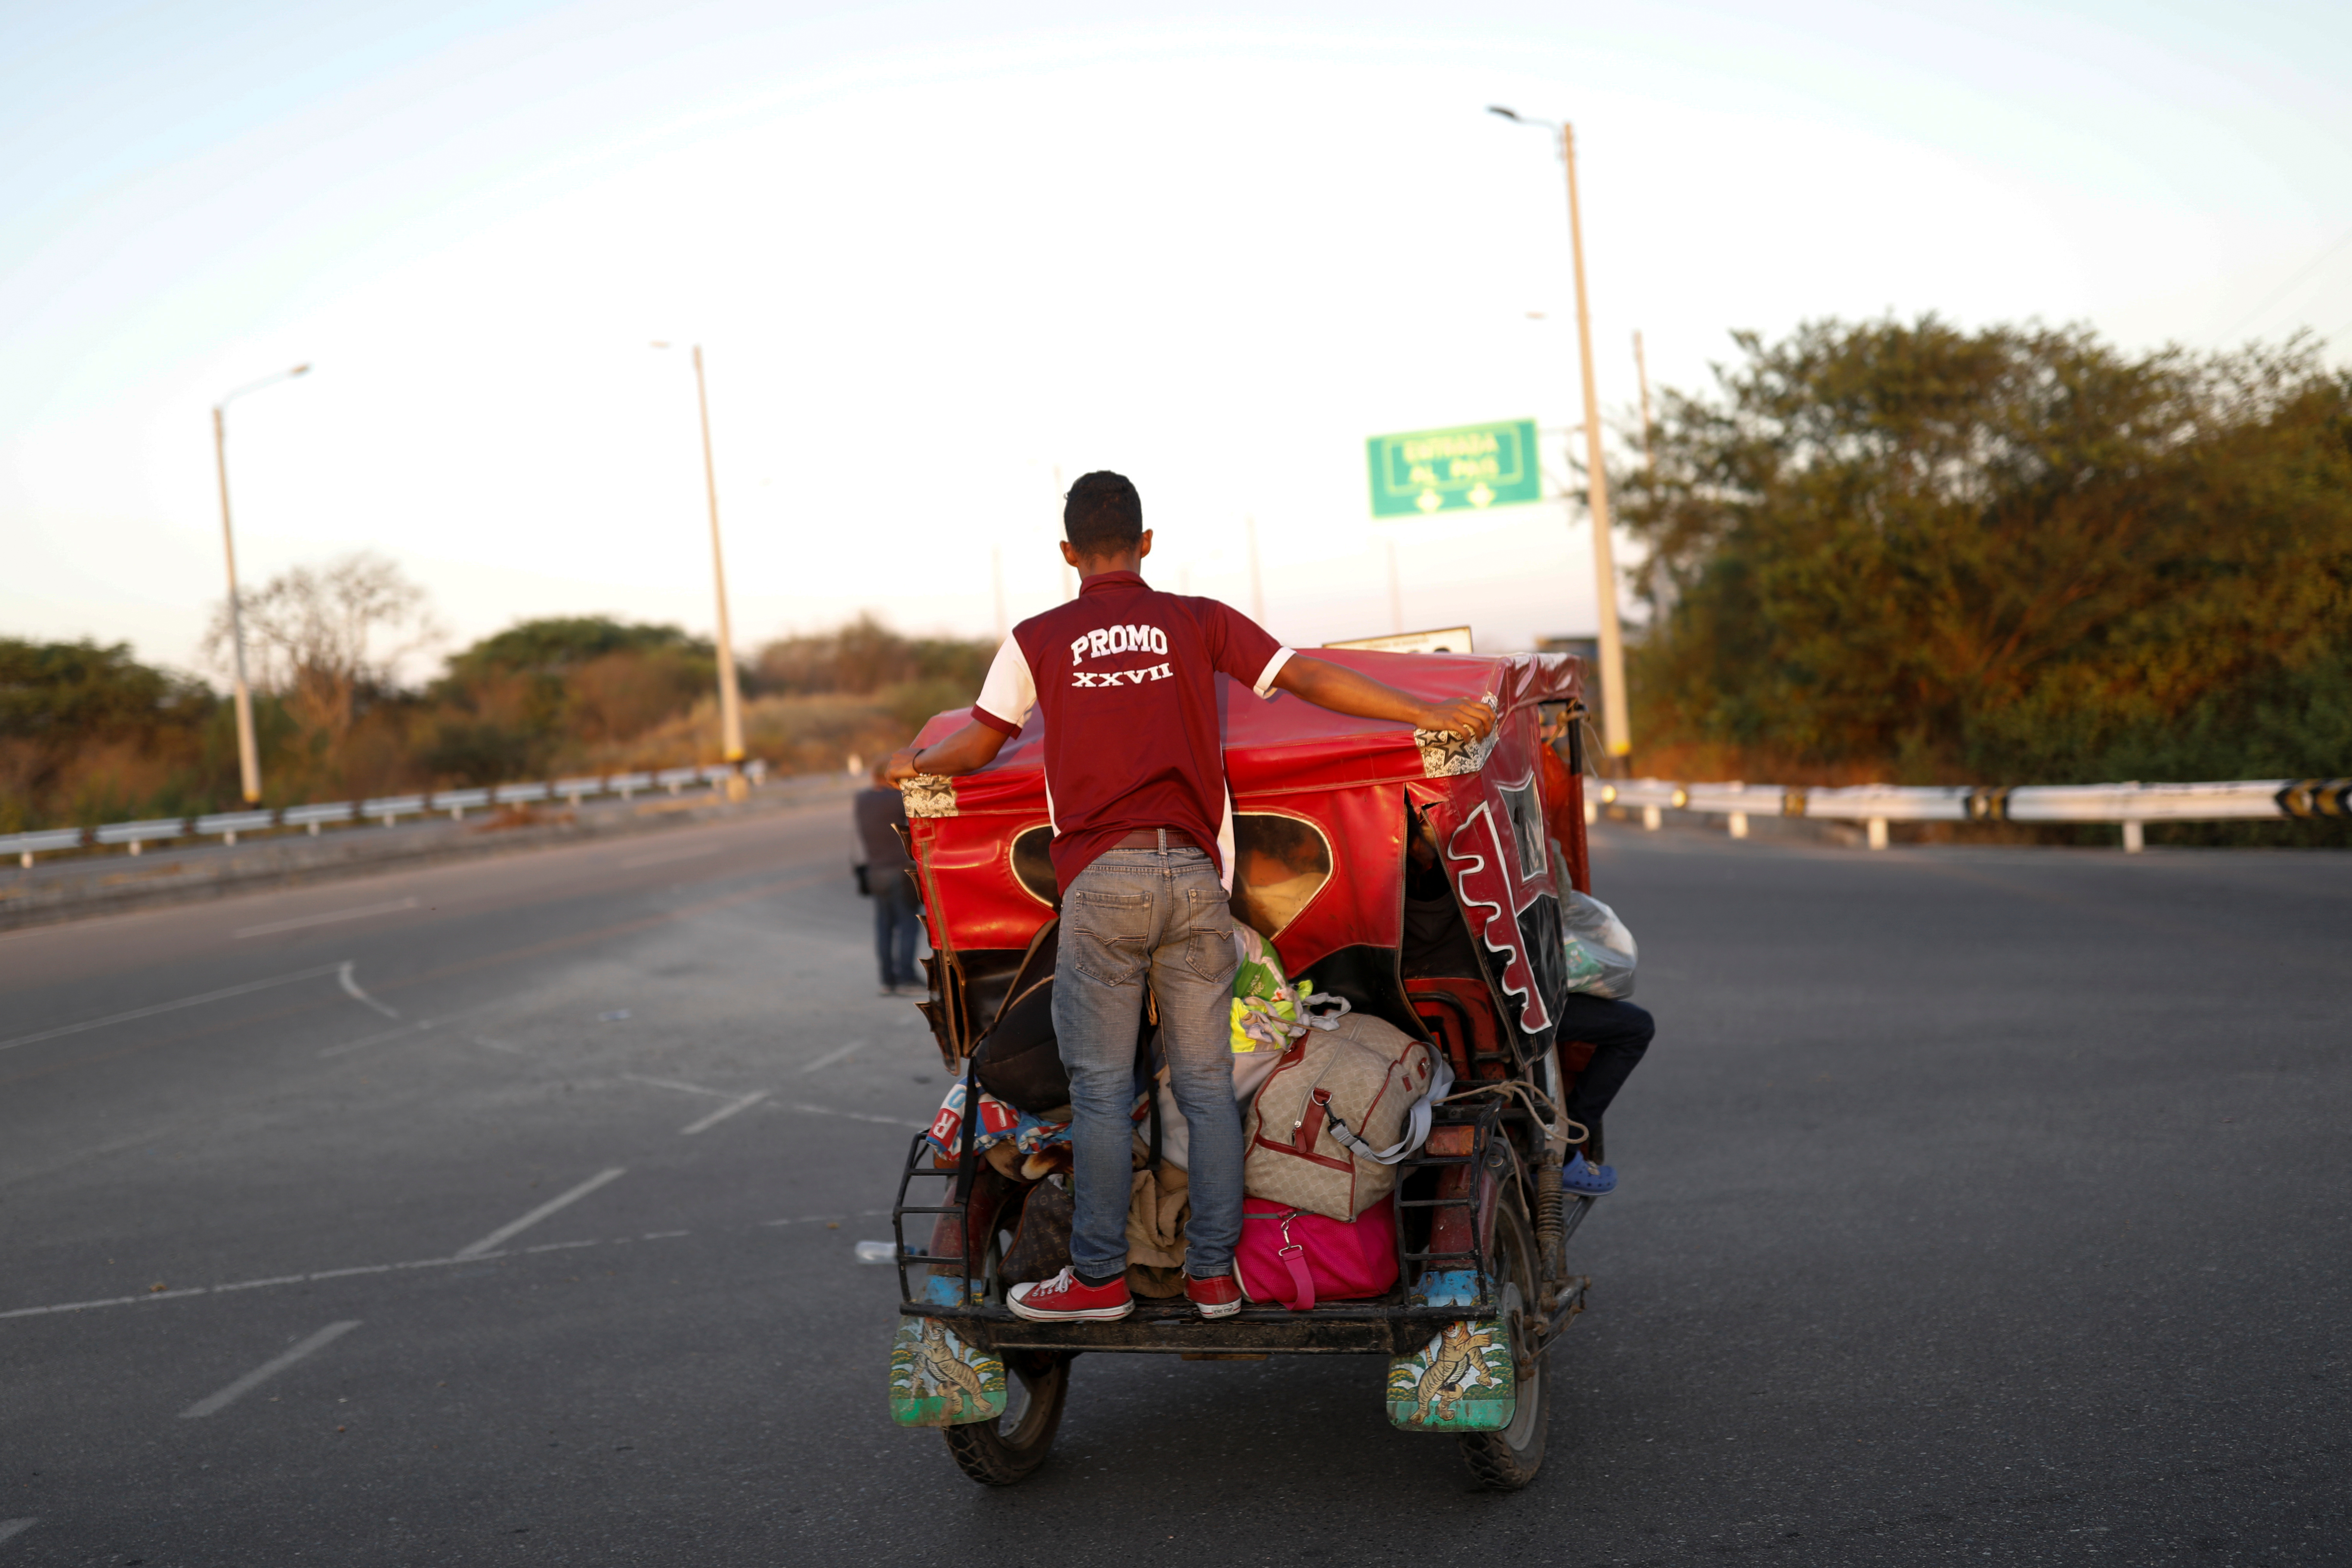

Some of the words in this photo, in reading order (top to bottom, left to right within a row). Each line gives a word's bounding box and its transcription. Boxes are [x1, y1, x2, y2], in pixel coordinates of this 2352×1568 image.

[1071, 624, 1168, 666] PROMO
[1071, 662, 1173, 687] XXVII
[933, 1113, 956, 1139] R
